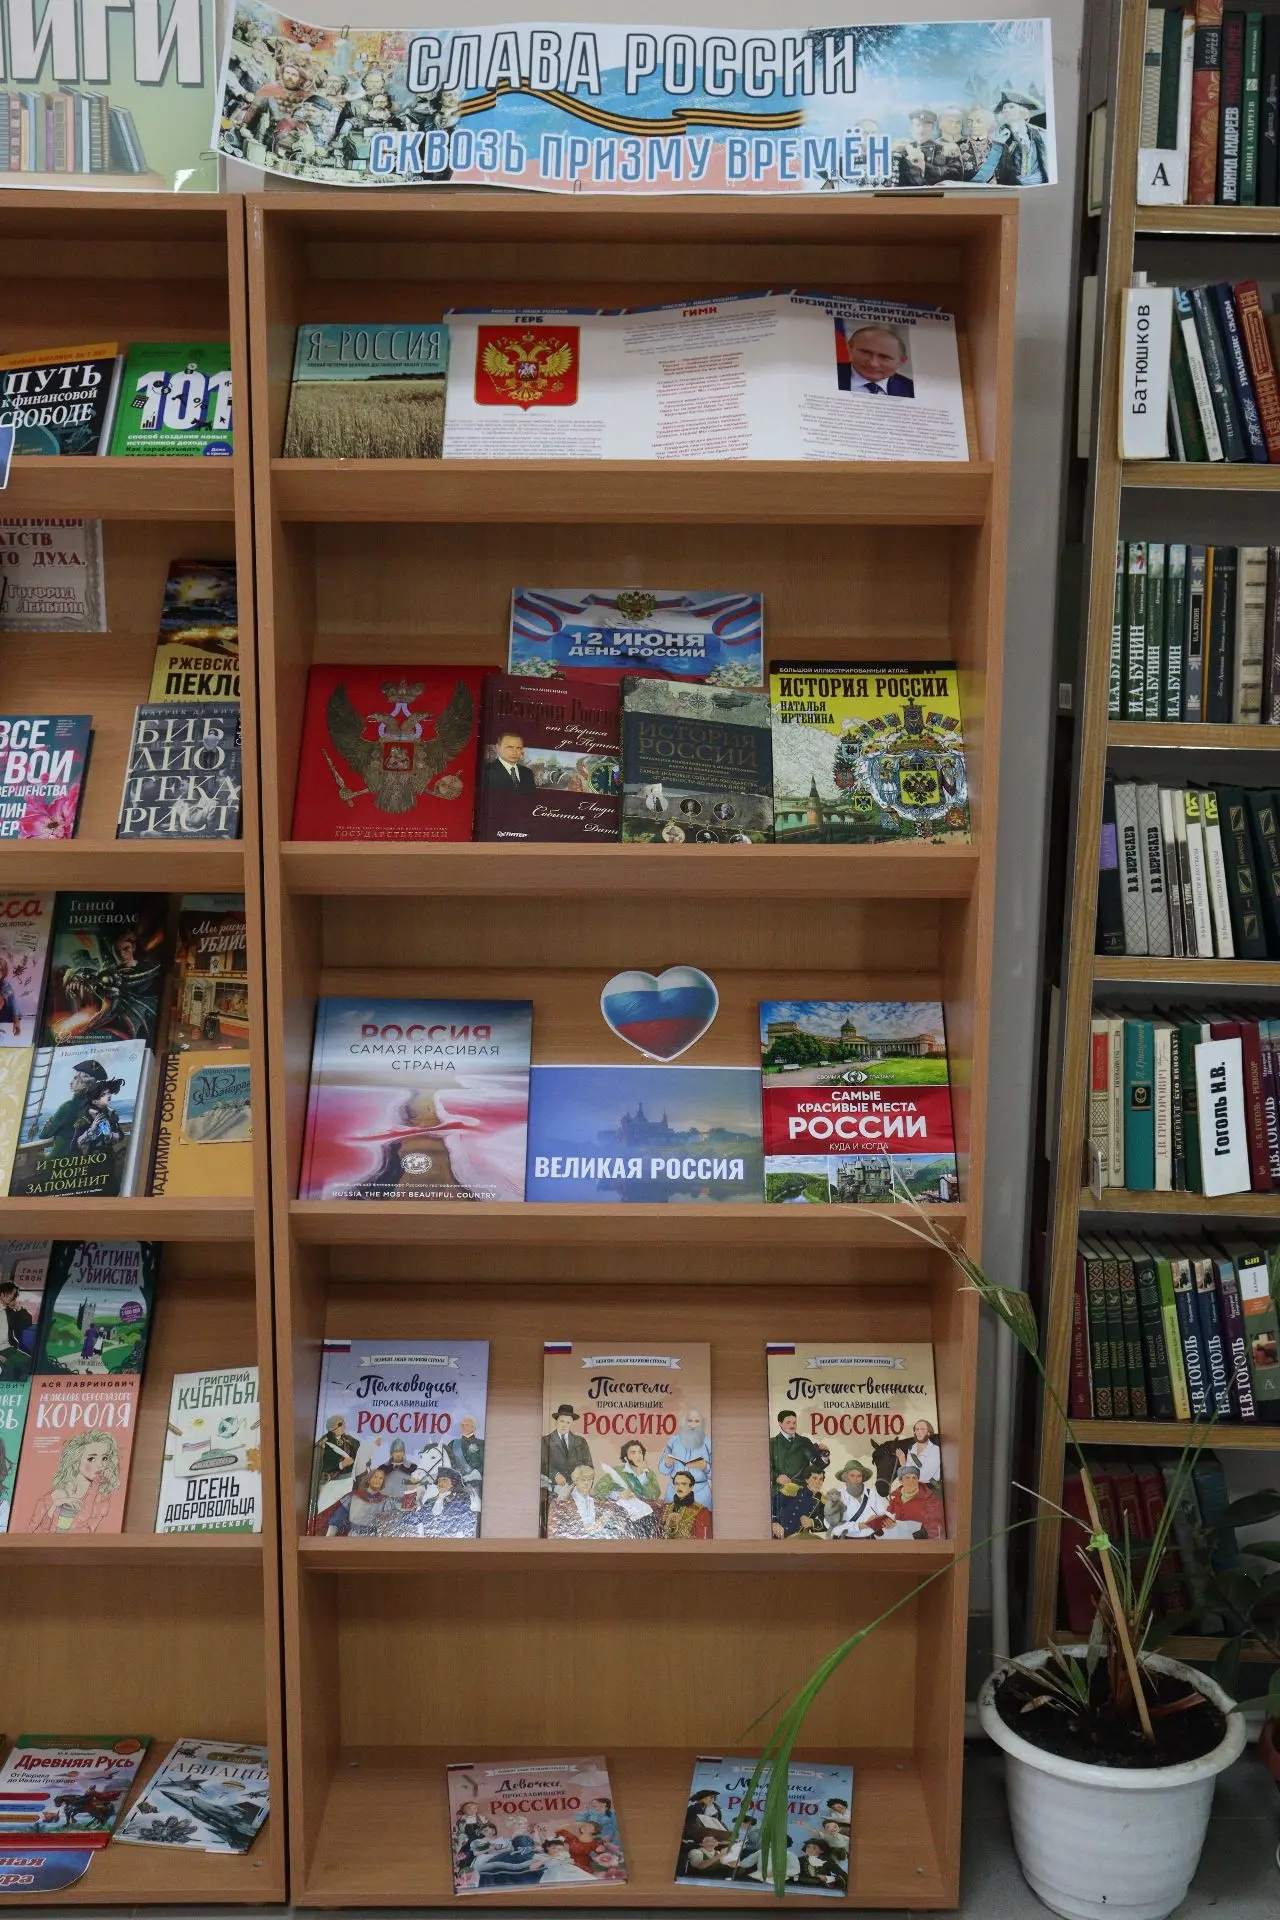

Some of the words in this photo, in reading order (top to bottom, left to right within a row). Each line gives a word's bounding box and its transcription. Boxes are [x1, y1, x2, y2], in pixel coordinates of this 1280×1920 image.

[0, 0, 205, 87] ИГИ
[407, 31, 600, 94] СЛАВА
[625, 33, 856, 97] РОССИИ
[1225, 107, 1239, 158] АНДРЕЕВ
[1247, 101, 1255, 142] АНДРЕЕВ
[372, 129, 525, 174] СКВОЗЬ
[541, 133, 712, 181] ПРИЗМУ
[726, 128, 891, 180] ВРЕМЁН
[1245, 147, 1255, 184] ЛЕОНИД
[1151, 162, 1170, 186] А
[1223, 157, 1238, 201] ЛЕОНИД
[515, 316, 543, 324] ГЕРБ
[682, 306, 717, 317] ГИМН
[790, 296, 856, 311] ПРЕЗИДЕНТ,
[859, 304, 950, 321] ПРАВИТЕЛЬСТВО
[836, 310, 917, 325] КОНСТИТУЦИЯ
[1132, 303, 1151, 415] Батюшков
[4, 365, 102, 395] ПУТЬ
[13, 388, 97, 408] финансовой
[136, 370, 233, 430] 101
[0, 402, 93, 428] СВОБОДЕ
[33, 552, 86, 566] ДУХА.
[572, 632, 602, 646] 12
[613, 633, 705, 647] ИЮНЯ
[569, 647, 621, 656] ДЕНЬ
[627, 647, 706, 657] РОССИИ
[1129, 624, 1144, 680] БУНИН
[1147, 645, 1160, 691] БУНИН
[1168, 645, 1181, 691] БУНИН
[780, 678, 867, 698] ИСТОРИЯ
[876, 677, 949, 697] РОССИИ
[780, 700, 826, 712] НАТАЛЬЯ
[780, 712, 835, 724] ИРТЕНИНА
[137, 718, 226, 744] БИБ
[638, 721, 757, 749] ИСТОРИЯ
[638, 737, 759, 768] РОССИИ
[126, 775, 240, 802] ТЕКА
[121, 805, 240, 833] РИСТ
[532, 805, 585, 821] События
[578, 802, 616, 819] Люди
[1124, 826, 1137, 874] ВЕРЕСАЕВ
[1147, 826, 1161, 874] ВЕРЕСАЕВ
[70, 899, 115, 912] Гений
[361, 1024, 491, 1042] РОССИЯ
[350, 1044, 407, 1055] САМАЯ
[413, 1045, 500, 1056] КРАСИВАЯ
[391, 1060, 456, 1071] СТРАНА
[162, 1052, 180, 1122] СОРОКИН
[1210, 1062, 1227, 1094] Н.В.
[797, 1102, 869, 1112] КРАСИВЫЕ
[872, 1102, 917, 1112] МЕСТА
[831, 1091, 881, 1101] САМЫЕ
[788, 1116, 928, 1139] РОССИИ
[1214, 1096, 1230, 1157] Гоголь
[1253, 1102, 1262, 1131] ГОГОЛЬ
[829, 1142, 850, 1151] КУДА
[861, 1142, 889, 1151] КОГДА
[36, 1160, 48, 1171] И
[51, 1152, 107, 1169] ТОЛЬКО
[51, 1166, 88, 1180] МОРЕ
[535, 1156, 643, 1179] ВЕЛИКАЯ
[650, 1157, 745, 1180] РОССИЯ
[26, 1174, 109, 1195] ЗАПОМНИТ
[408, 1191, 454, 1199] BEAUTIFUL
[76, 1268, 138, 1286] УБИЙСТВА
[1184, 1335, 1203, 1386] ГОГОЛЬ
[1208, 1335, 1226, 1386] ГОГОЛЬ
[1231, 1337, 1250, 1389] ГОГОЛЬ
[66, 1380, 135, 1388] ЛАВРИНОВИЧ
[199, 1370, 250, 1384] ГРИГОРИЙ
[356, 1373, 458, 1398] Полководцы,
[588, 1376, 673, 1399] Писатели,
[787, 1377, 927, 1400] Путешественники,
[178, 1381, 256, 1411] КУБАТЬЯ
[372, 1400, 439, 1408] ПРОСЛАВИВШИЕ
[824, 1401, 890, 1409] ПРОСЛАВИВШИЕ
[36, 1402, 131, 1429] КОРОЛЯ
[357, 1410, 452, 1434] РОССИЮ
[583, 1412, 677, 1435] РОССИЮ
[811, 1413, 905, 1435] РОССИЮ
[186, 1475, 240, 1502] ОСЕНЬ
[164, 1496, 255, 1524] ДОБРОВОЛЬЦА
[13, 1754, 94, 1771] Древняя
[94, 1755, 135, 1772] Русь
[490, 1797, 581, 1815] РОССИЮ
